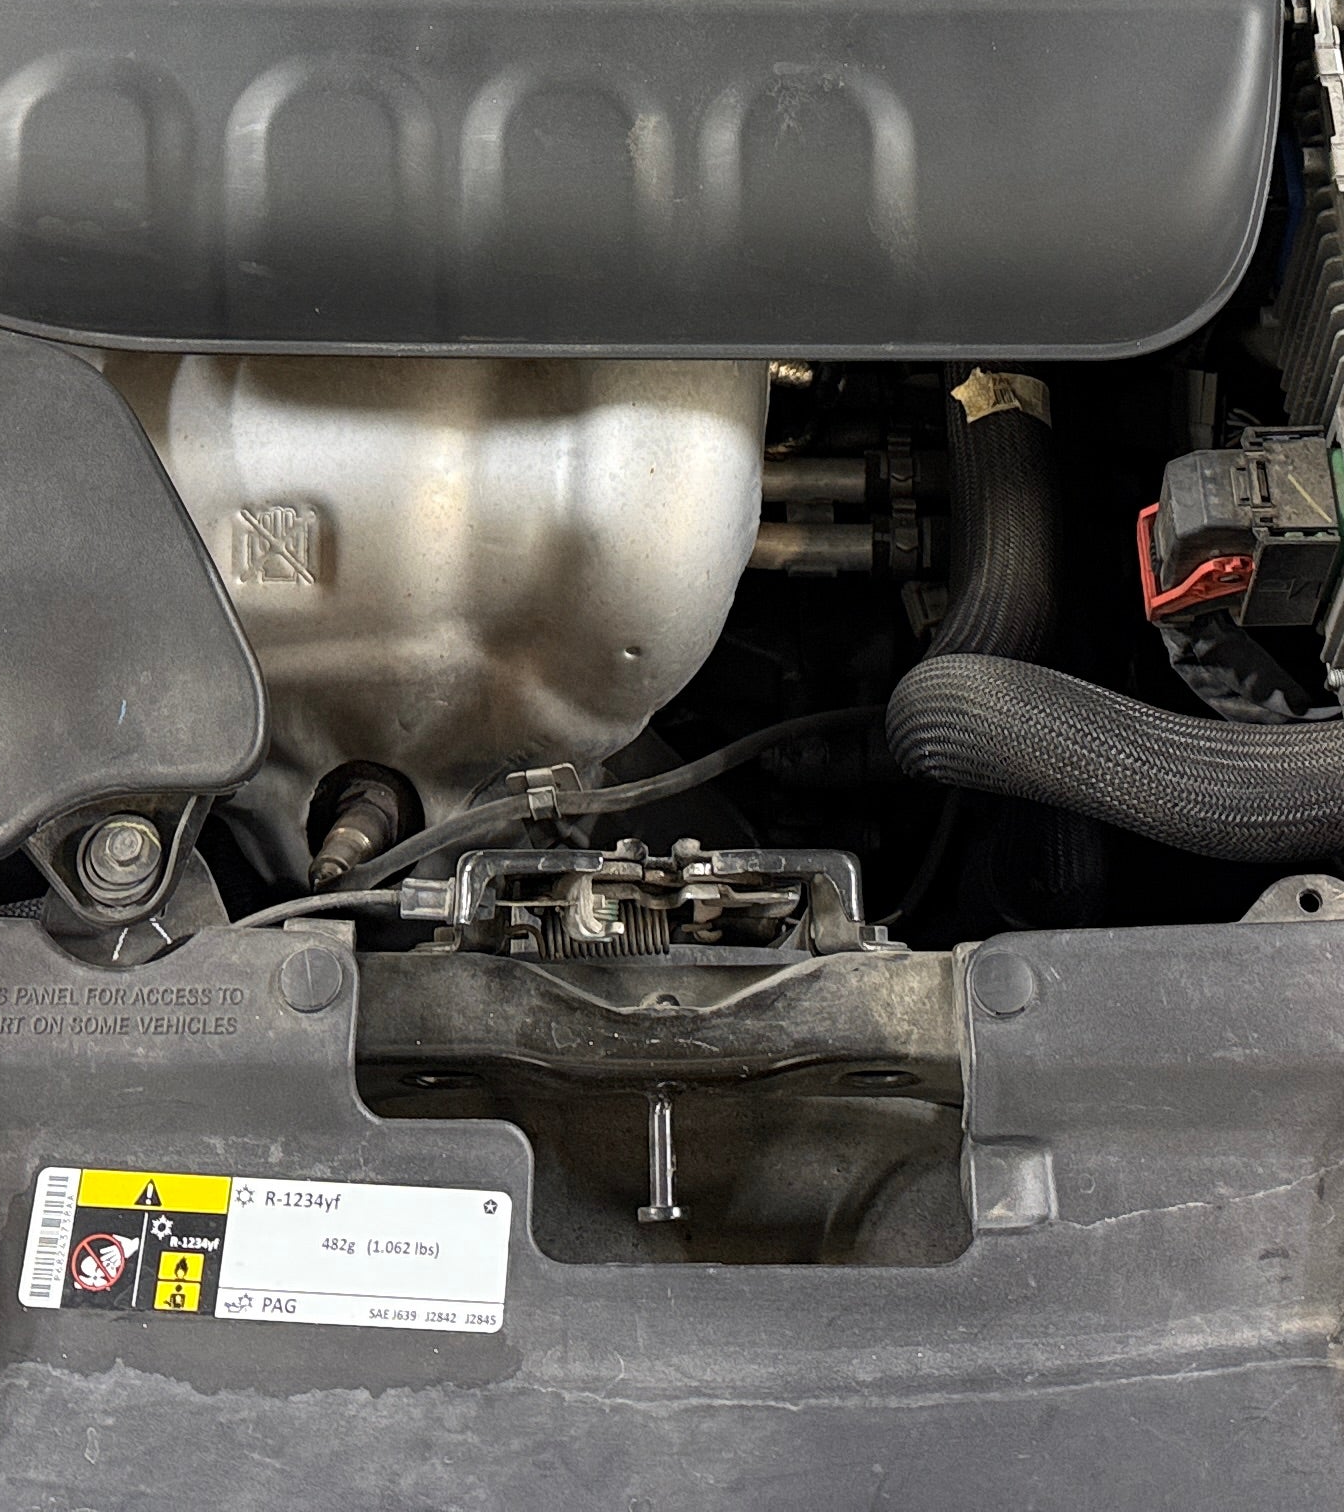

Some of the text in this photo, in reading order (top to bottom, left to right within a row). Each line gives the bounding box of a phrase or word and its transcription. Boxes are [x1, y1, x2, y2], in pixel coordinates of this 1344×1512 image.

[12, 985, 79, 1006] PANEL
[84, 985, 127, 1006] FOR
[130, 985, 213, 1006] ACCESS
[217, 985, 245, 1006] TO
[31, 1015, 65, 1036] ON
[69, 1015, 131, 1036] SOME
[136, 1015, 239, 1036] VEHICLES
[264, 1190, 342, 1213] R-1234yf
[321, 1237, 441, 1259] 482g (1.062 lbs)
[261, 1296, 297, 1315] PAG
[369, 1307, 391, 1320] SAE
[392, 1308, 417, 1321] J639
